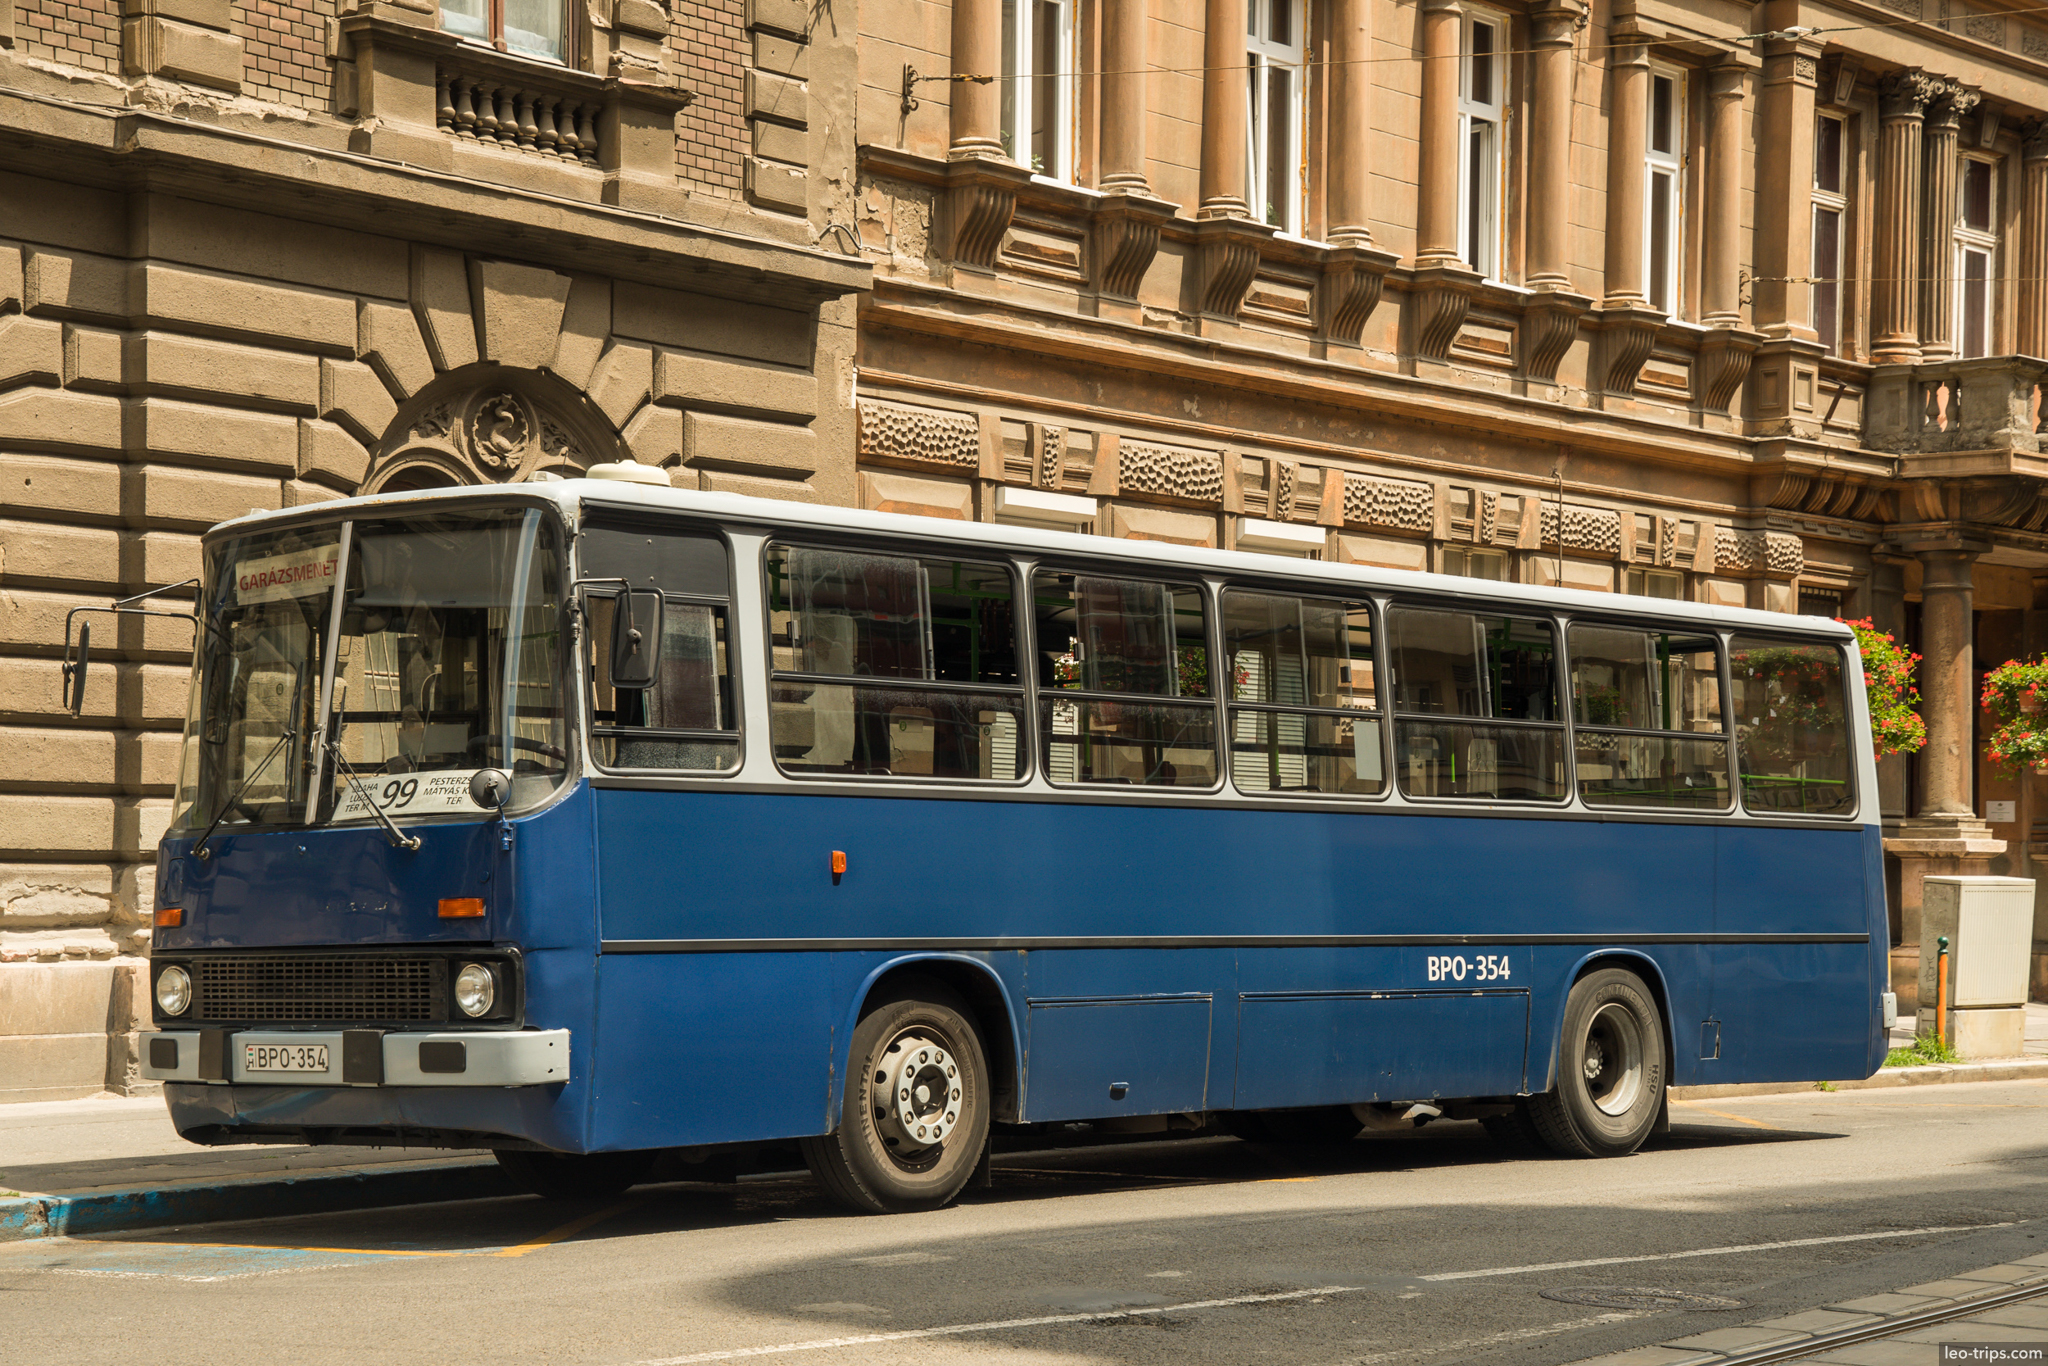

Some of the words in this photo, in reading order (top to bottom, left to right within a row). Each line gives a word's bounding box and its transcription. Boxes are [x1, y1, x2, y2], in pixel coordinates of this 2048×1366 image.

[239, 559, 339, 591] GARÁZSMENET
[379, 779, 418, 809] 99
[423, 785, 461, 796] MÁTYÁS
[446, 795, 463, 805] TÉR
[345, 803, 359, 812] TÉR
[1427, 955, 1511, 981] BPO-354
[258, 1047, 326, 1068] BPO-354
[1650, 1065, 1658, 1094] HSU
